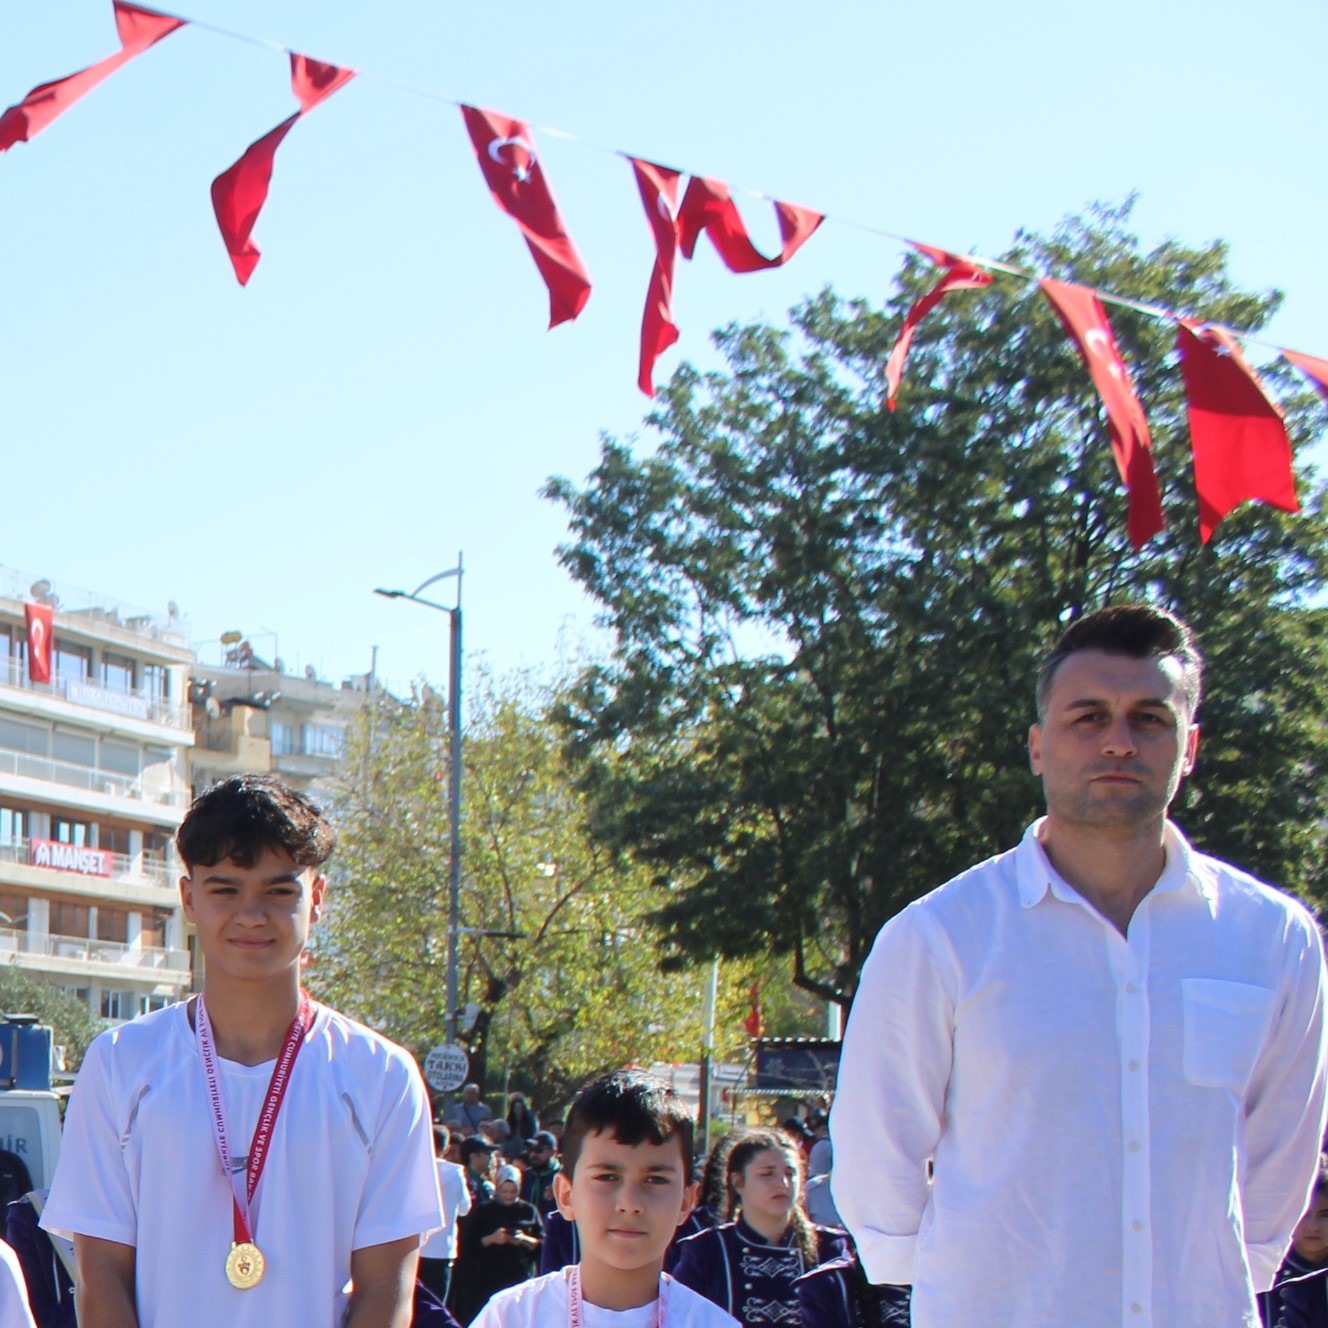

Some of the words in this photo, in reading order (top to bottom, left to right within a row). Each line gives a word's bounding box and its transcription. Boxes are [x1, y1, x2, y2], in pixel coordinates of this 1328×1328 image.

[52, 844, 106, 874] MANŞET
[200, 1027, 209, 1039] VE
[202, 1039, 214, 1075] GENÇLİK
[276, 1048, 296, 1095] CUMHURİYETİ
[209, 1076, 225, 1133] CUMHURİYETİ
[261, 1094, 279, 1134] GENÇLİK
[219, 1135, 231, 1172] TÜRKİYE
[259, 1134, 270, 1146] VE
[251, 1146, 264, 1171] SPOR
[572, 1306, 580, 1317] VE
